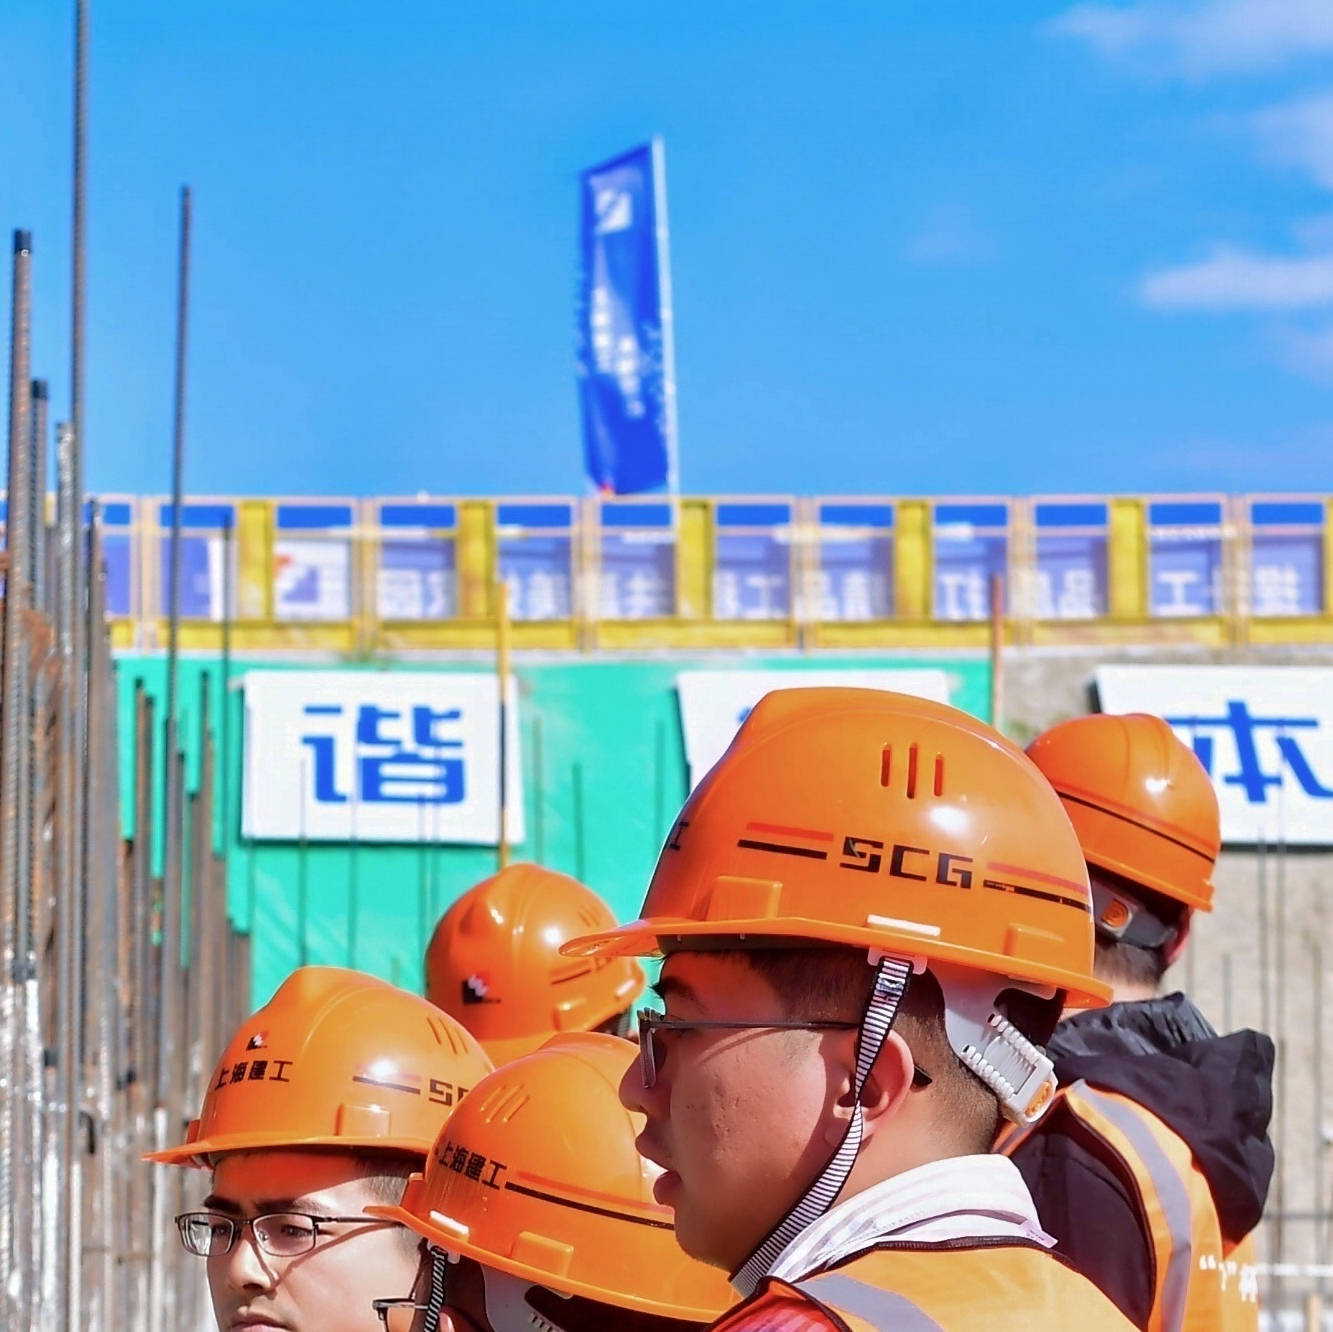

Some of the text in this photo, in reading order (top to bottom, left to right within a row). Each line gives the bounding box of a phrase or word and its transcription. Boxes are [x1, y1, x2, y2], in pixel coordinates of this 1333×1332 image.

[302, 703, 466, 804] 谐
[839, 836, 974, 889] SCG
[214, 1059, 294, 1091] 上海建工
[438, 1140, 508, 1191] 上海建工
